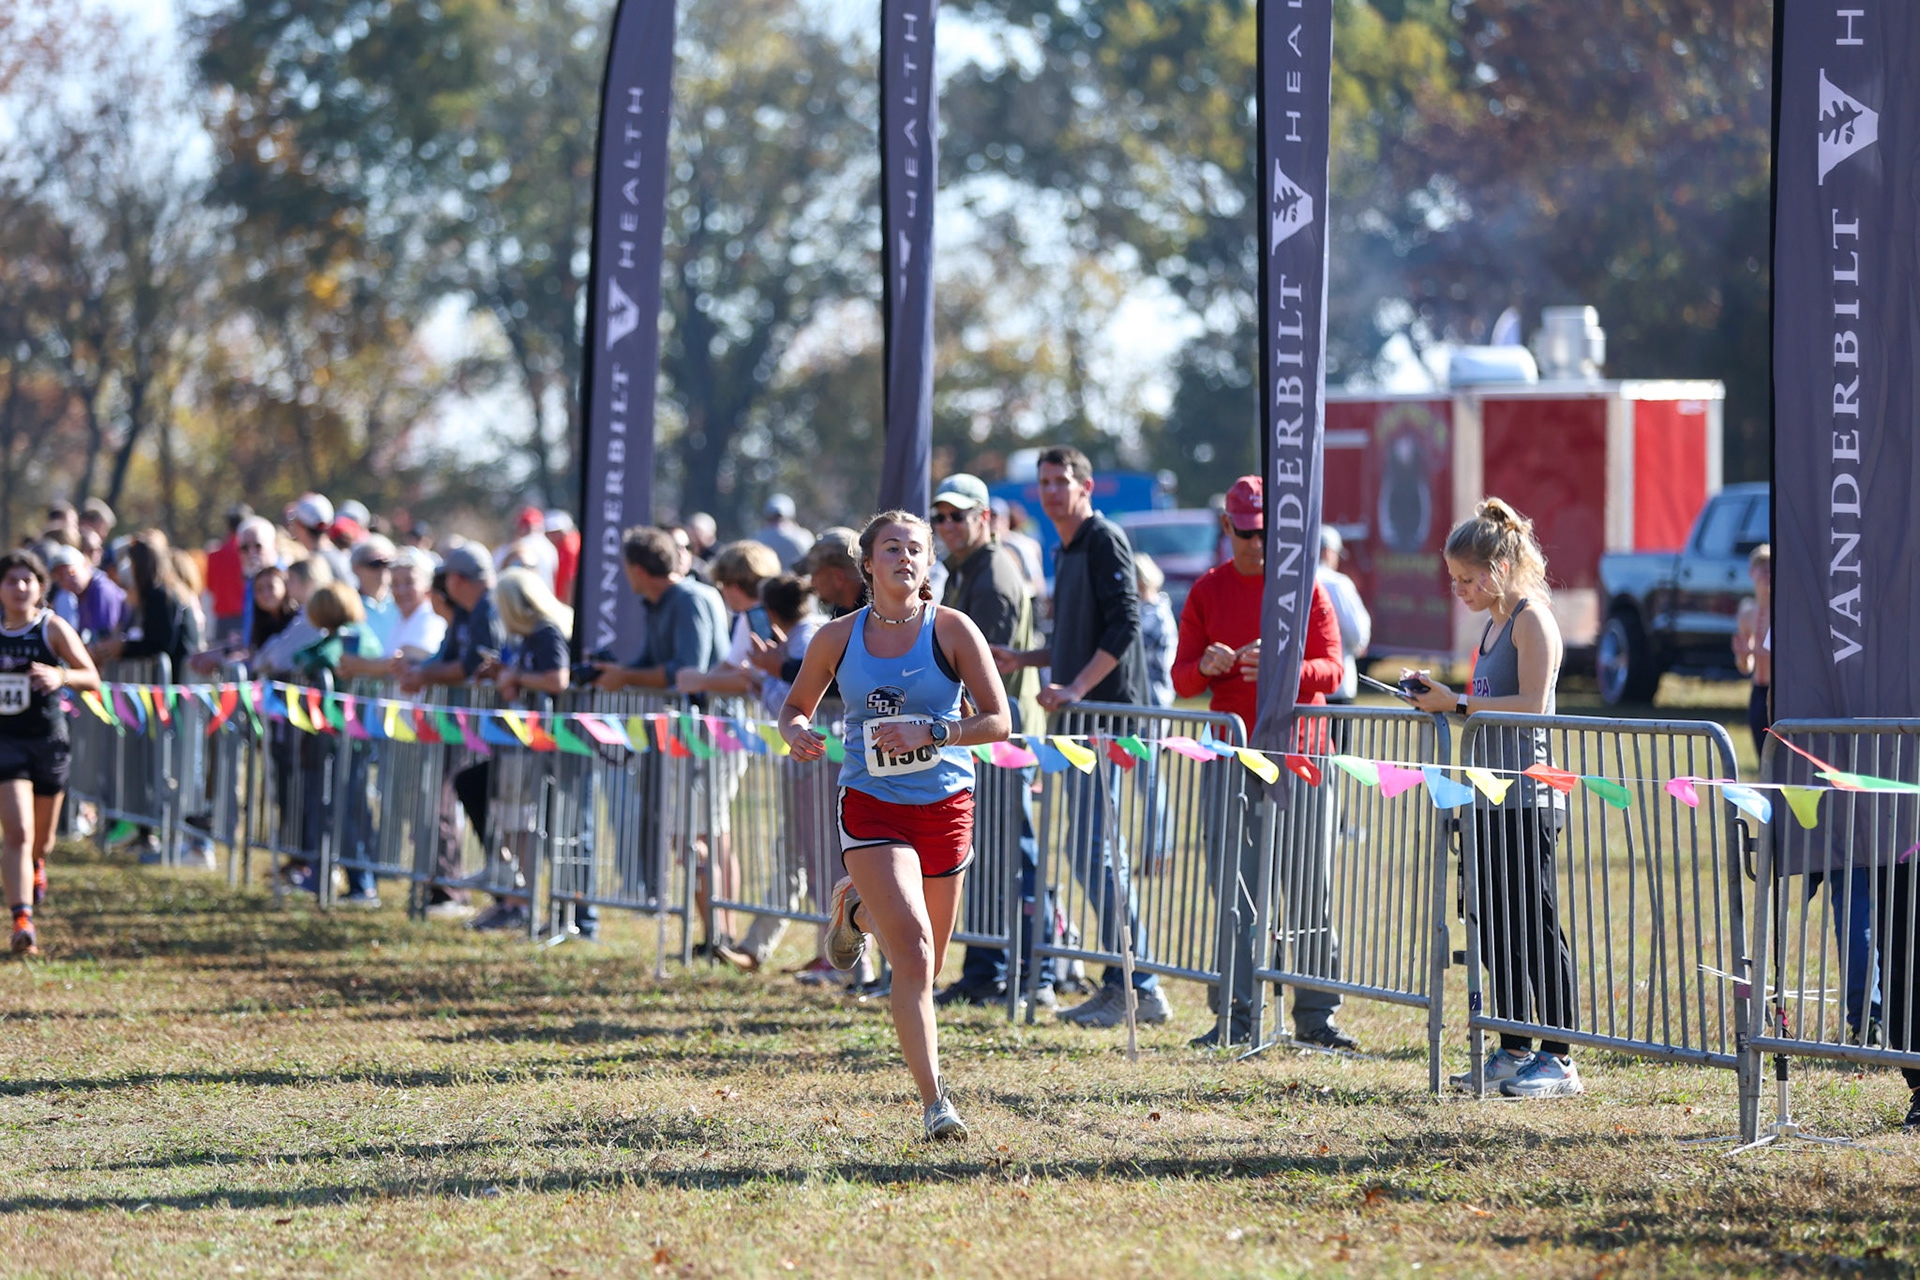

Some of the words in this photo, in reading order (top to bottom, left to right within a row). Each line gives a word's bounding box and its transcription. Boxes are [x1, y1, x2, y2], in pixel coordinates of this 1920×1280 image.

[1836, 9, 1865, 46] H
[596, 361, 631, 648] VANDERBILT
[619, 86, 644, 269] HEALTH
[1829, 208, 1862, 667] VANDERBILT
